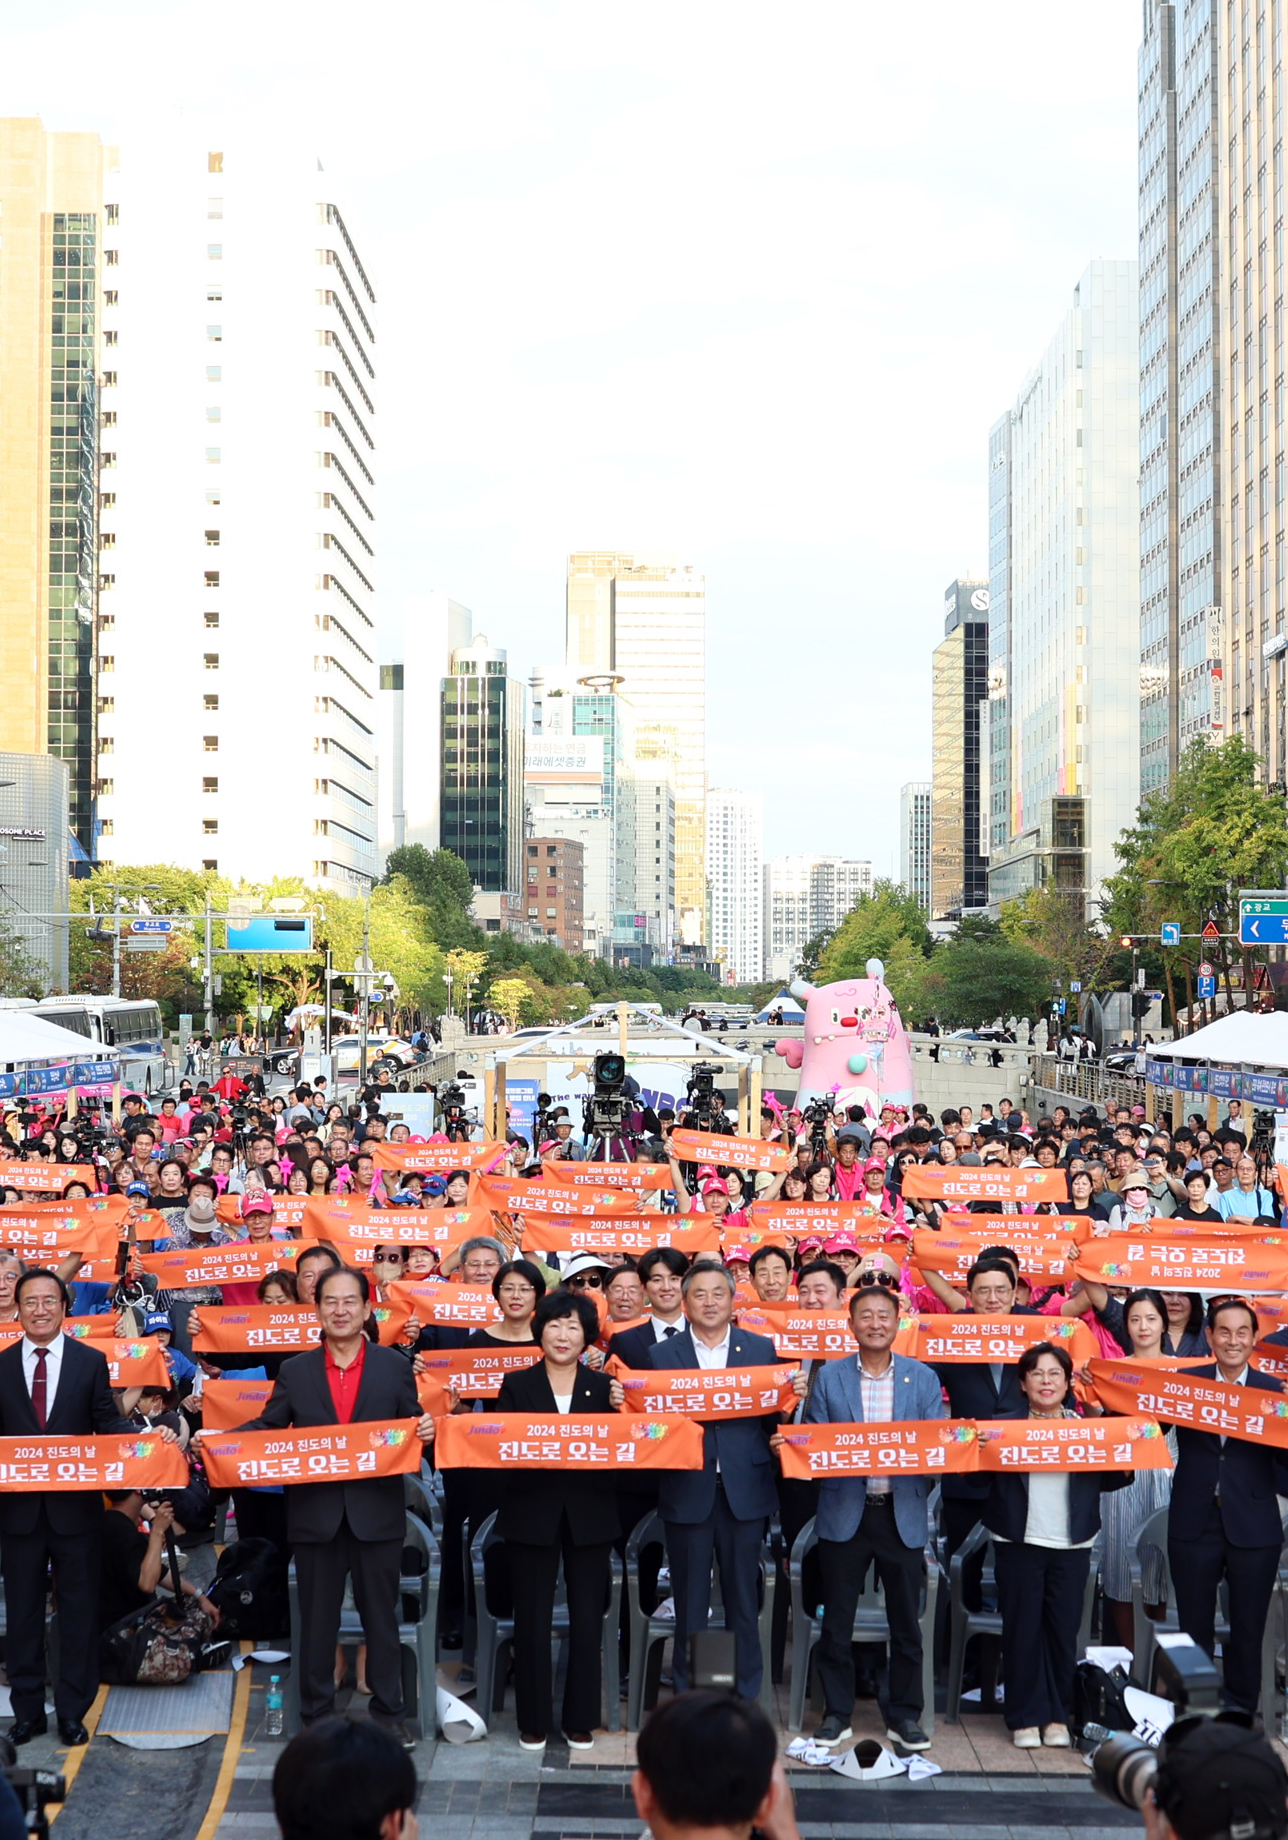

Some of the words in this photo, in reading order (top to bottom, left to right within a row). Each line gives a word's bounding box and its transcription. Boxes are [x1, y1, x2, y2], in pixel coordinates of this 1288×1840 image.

[565, 743, 586, 755] 연금
[1254, 902, 1271, 912] 광교
[1201, 966, 1211, 974] 30
[1202, 977, 1210, 986] P
[309, 1035, 315, 1045] 1
[550, 1094, 570, 1102] The
[711, 1140, 731, 1149] 2024
[725, 1141, 749, 1151] 진도의
[695, 1148, 730, 1162] 진도로
[733, 1152, 756, 1166] 오는
[759, 1156, 771, 1168] 길
[959, 1172, 979, 1181] 2024
[979, 1173, 1002, 1182] 진도의
[1002, 1174, 1011, 1182] 날
[942, 1182, 982, 1195] 진도로
[984, 1183, 1012, 1197] 오는
[1014, 1184, 1028, 1197] 길
[30, 1218, 37, 1228] 날
[7, 1230, 38, 1244] 오는
[42, 1231, 58, 1246] 길
[1163, 1382, 1190, 1396] 2024
[1194, 1388, 1226, 1404] 진도의
[1229, 1394, 1240, 1407] 날
[1137, 1394, 1194, 1420] 진도로
[1199, 1406, 1239, 1430] 오는
[1246, 1415, 1264, 1435] 길
[471, 1421, 505, 1434] Jindo
[527, 1424, 556, 1436] 2024
[559, 1424, 594, 1438] 진도의
[597, 1425, 609, 1438] 날
[14, 1447, 44, 1459] 2024
[47, 1446, 81, 1459] 진도의
[84, 1445, 97, 1458] 날
[264, 1441, 294, 1454] 2024
[298, 1437, 332, 1452] 진도의
[335, 1436, 347, 1449] 날
[499, 1441, 561, 1460] 진도로
[567, 1442, 609, 1461] 오는
[616, 1442, 635, 1462] 길
[56, 1463, 98, 1482] 오는
[104, 1462, 124, 1482] 길
[238, 1458, 302, 1480] 진도로
[308, 1454, 350, 1474] 오는
[356, 1450, 376, 1472] 길
